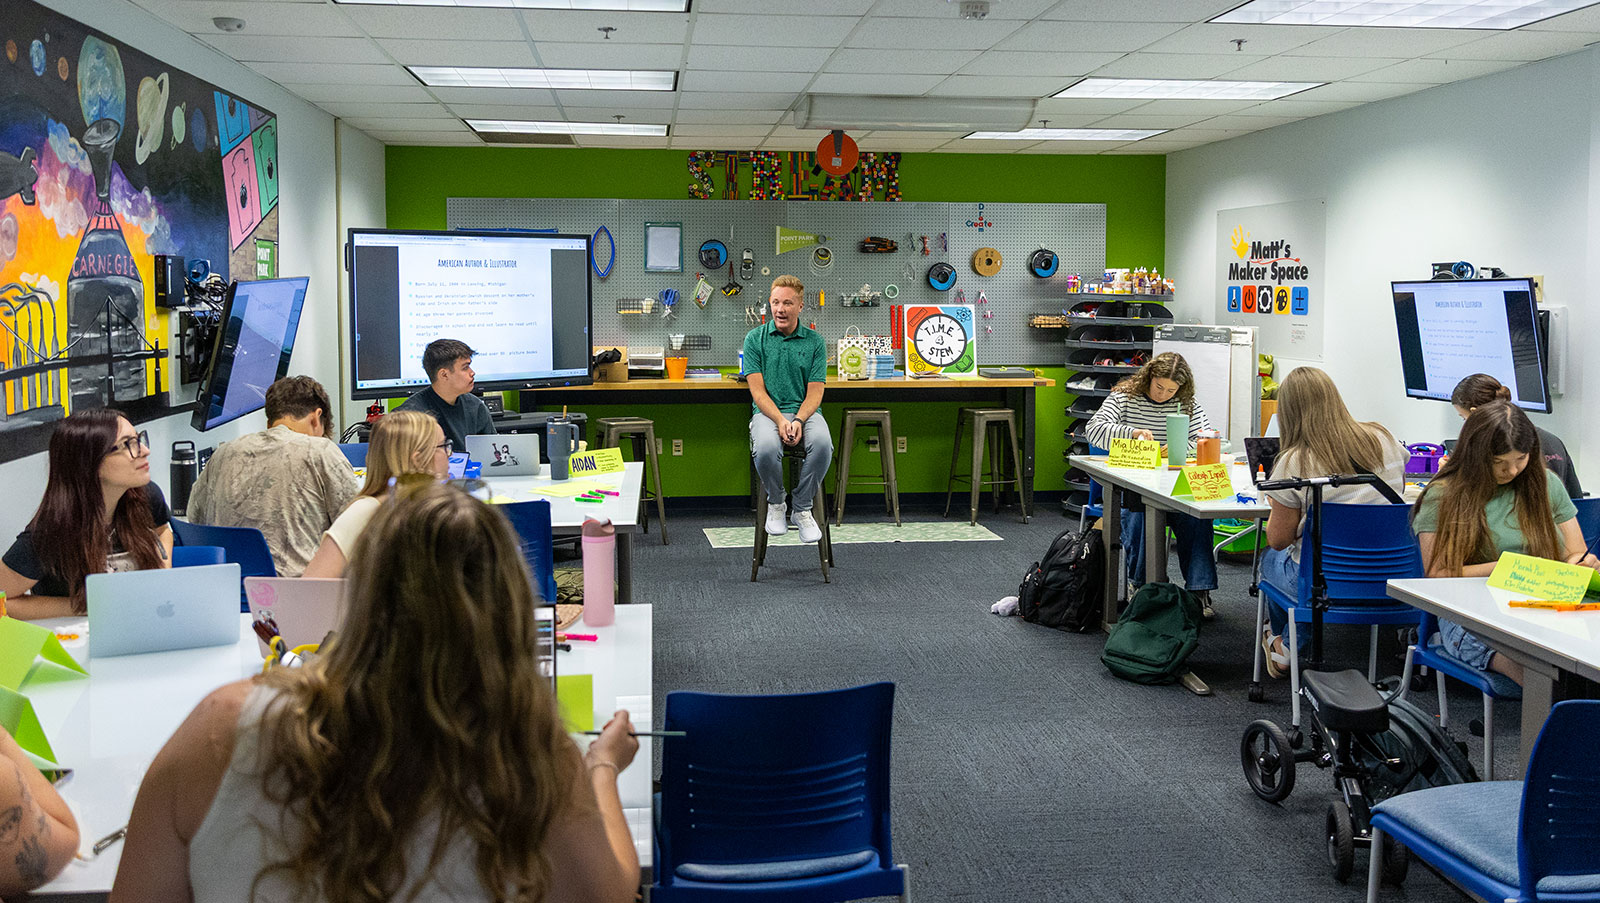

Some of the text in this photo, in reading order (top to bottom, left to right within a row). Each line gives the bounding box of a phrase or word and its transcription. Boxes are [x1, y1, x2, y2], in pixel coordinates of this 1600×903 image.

[687, 150, 902, 201] STREAM
[1250, 240, 1291, 260] Matt's
[72, 253, 136, 278] CARNEGIE
[437, 259, 463, 268] AMERICAN
[464, 259, 482, 268] AUTHOR
[489, 259, 517, 268] ILLUSTRATOR
[1228, 261, 1308, 285] Maker Space
[928, 346, 954, 358] STEM
[572, 456, 597, 472] AIDAN
